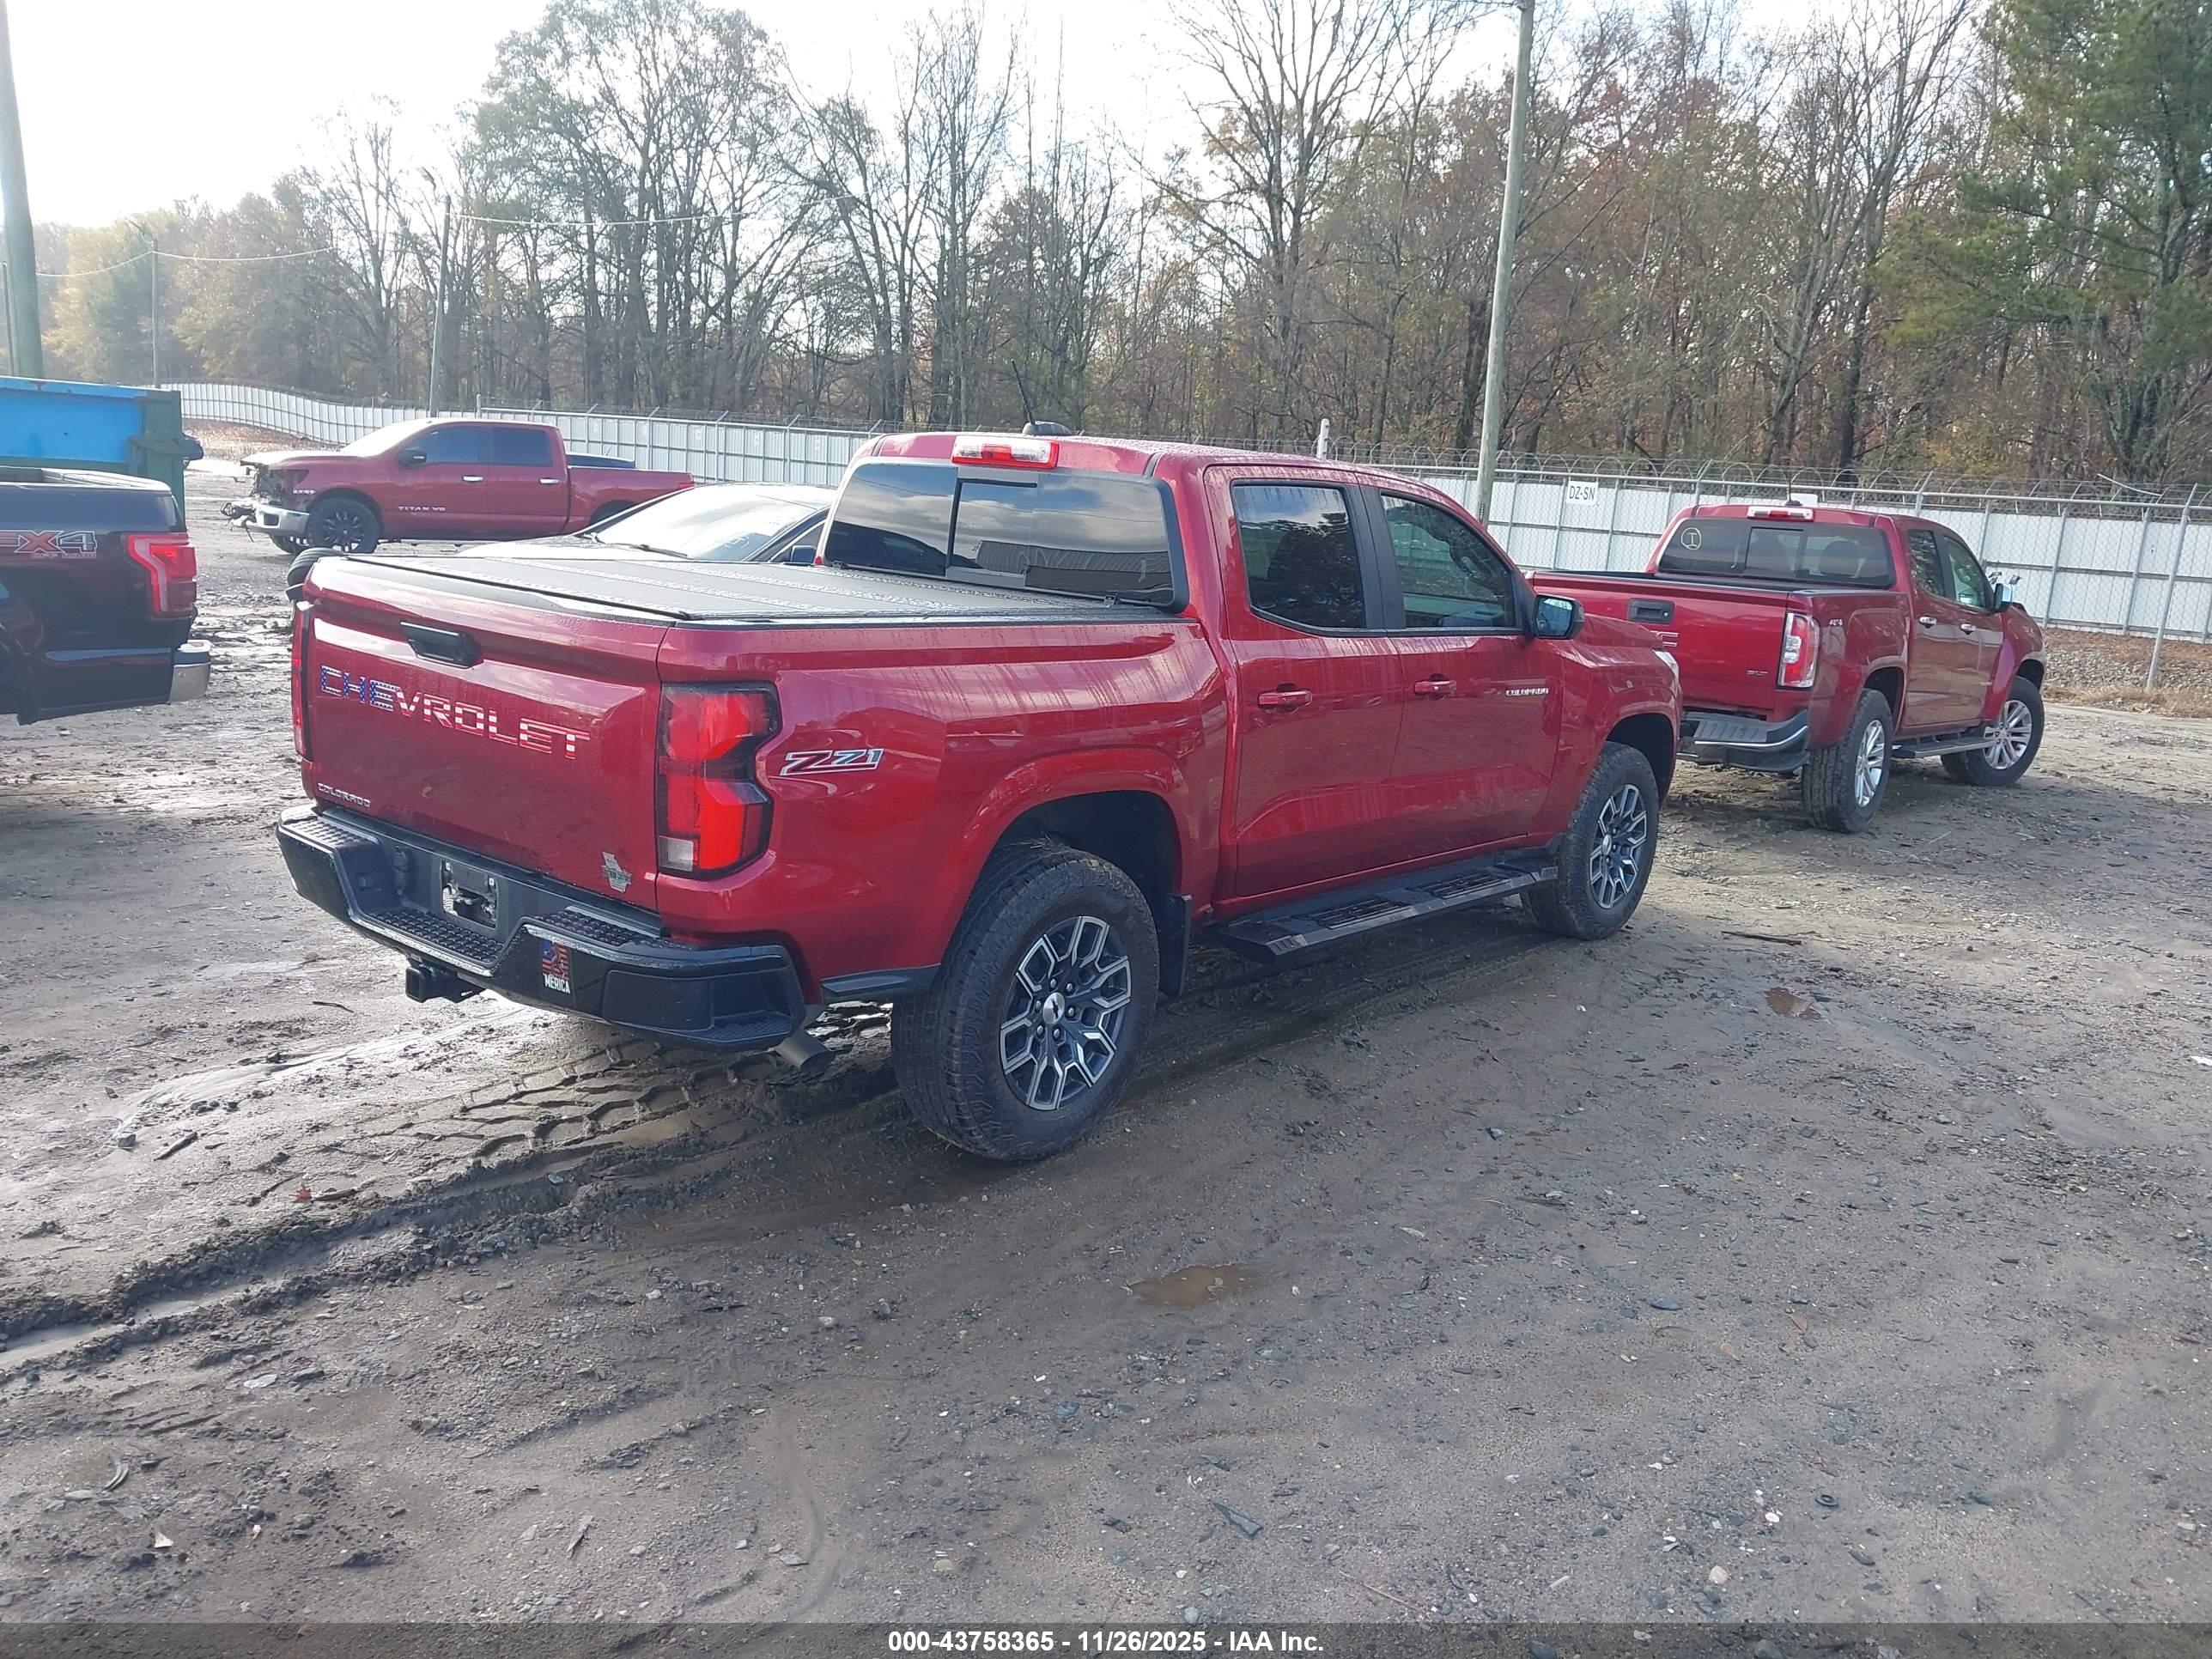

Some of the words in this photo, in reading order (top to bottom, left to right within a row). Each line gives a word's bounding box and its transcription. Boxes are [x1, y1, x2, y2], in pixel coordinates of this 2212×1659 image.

[1570, 485, 1595, 501] DZ-SN
[1505, 687, 1549, 696] COLORADO
[320, 665, 591, 759] CHEVROLET
[779, 748, 884, 776] Z71
[317, 782, 371, 808] COLORADO
